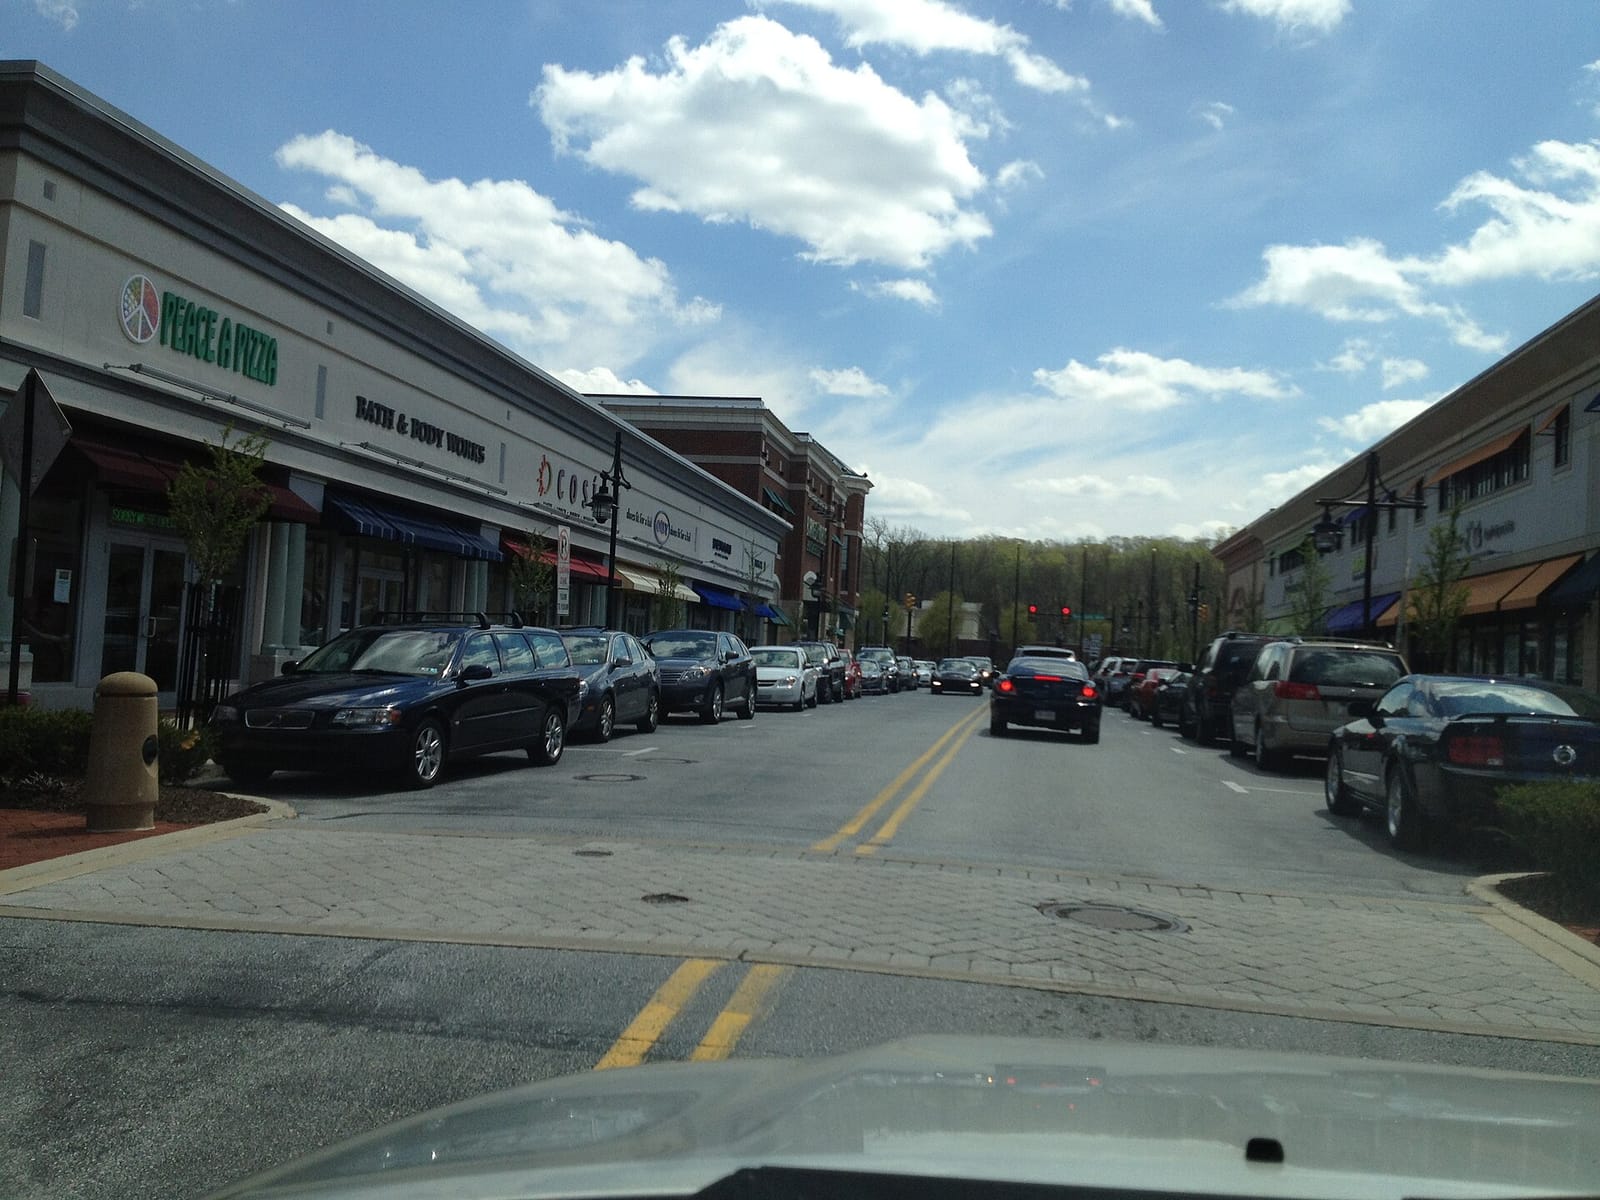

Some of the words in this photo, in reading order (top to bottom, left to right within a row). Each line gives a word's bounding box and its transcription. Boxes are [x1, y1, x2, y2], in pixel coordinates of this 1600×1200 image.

[160, 291, 218, 364] PEACE
[217, 317, 232, 369] A
[233, 323, 278, 386] PIZZA
[356, 395, 396, 430] BATH
[397, 413, 408, 435] &
[410, 418, 444, 449] BODY
[446, 431, 485, 464] WORKS
